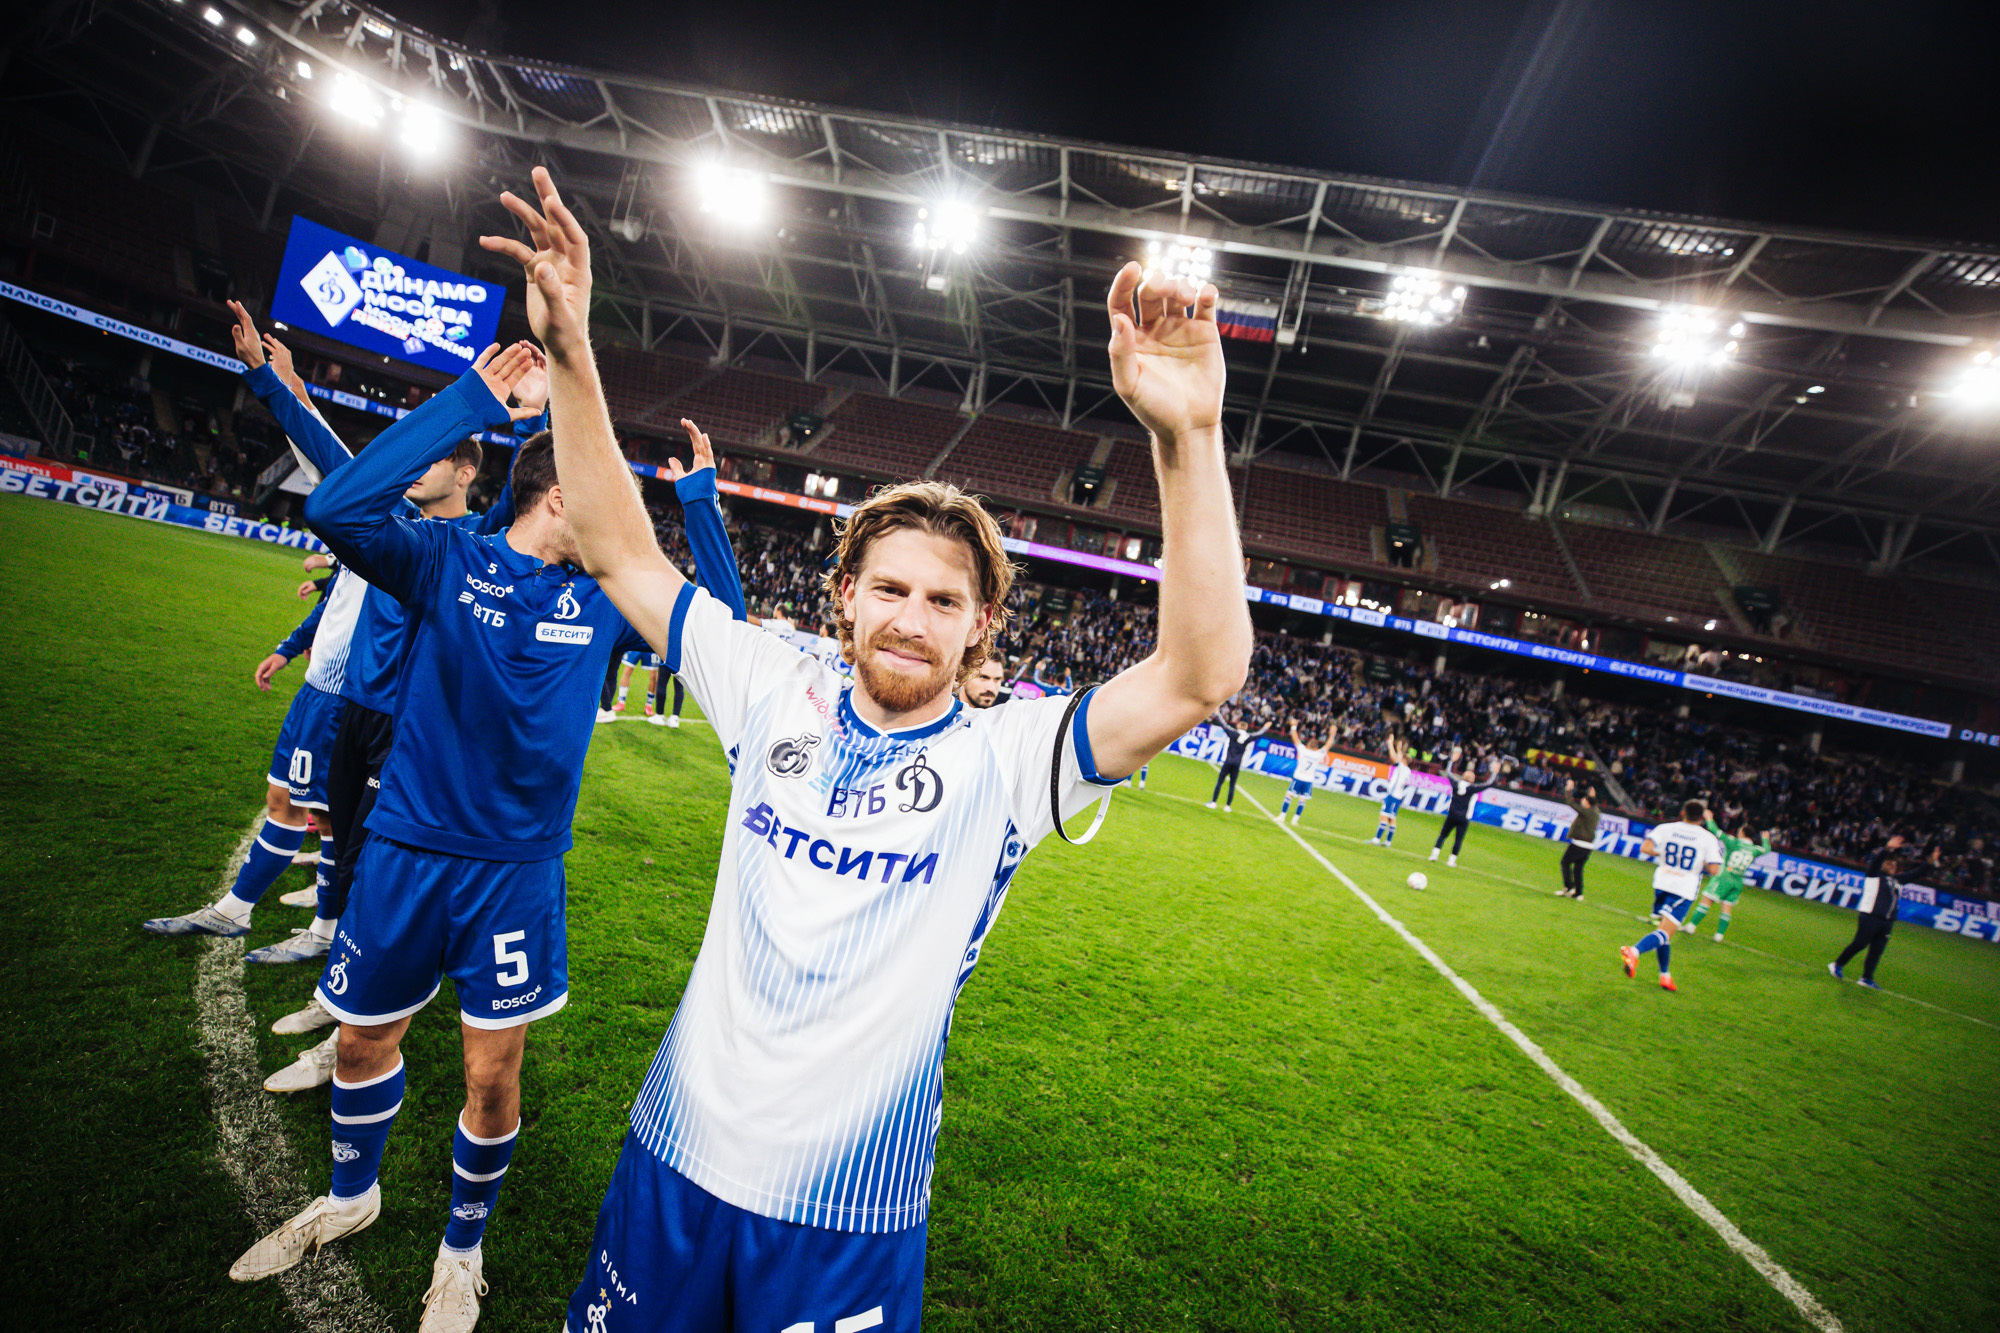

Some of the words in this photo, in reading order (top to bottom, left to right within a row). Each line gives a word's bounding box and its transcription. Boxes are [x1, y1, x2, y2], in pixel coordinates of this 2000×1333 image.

[360, 270, 487, 303] ДИНАМО
[364, 289, 473, 327] МОСКВА
[1, 284, 78, 316] HANGAN
[95, 317, 172, 348] CHANGAN
[187, 347, 248, 372] CHANGA
[377, 404, 394, 416] ВТБ
[0, 469, 170, 521] БЕТСИТИ
[209, 501, 237, 516] ВТБ
[204, 512, 330, 554] БЕТСИТ
[487, 562, 499, 575] 5
[466, 573, 506, 598] BOSCO
[473, 602, 507, 628] ВТБ
[541, 628, 592, 640] БЕТСИТИ
[1456, 630, 1519, 651] БЕТСИТИ
[1532, 646, 1597, 667] БЕТСИТИ
[1609, 661, 1677, 683] БЕТСИТИ
[1268, 742, 1295, 759] ВТБ
[1960, 729, 2000, 747] DRE
[1306, 760, 1314, 772] 7
[826, 784, 887, 818] ВТБ
[742, 801, 940, 884] БЕТСИТИ
[1501, 808, 1648, 862] БЕТИТ
[1664, 842, 1697, 870] 88
[1742, 862, 1864, 912] ЕТСИТ
[1782, 859, 1865, 888] БЕТСИТ
[339, 930, 362, 957] DIGMA
[493, 930, 530, 987] 5
[492, 991, 536, 1011] BOSCO
[601, 1249, 637, 1304] DIGMA
